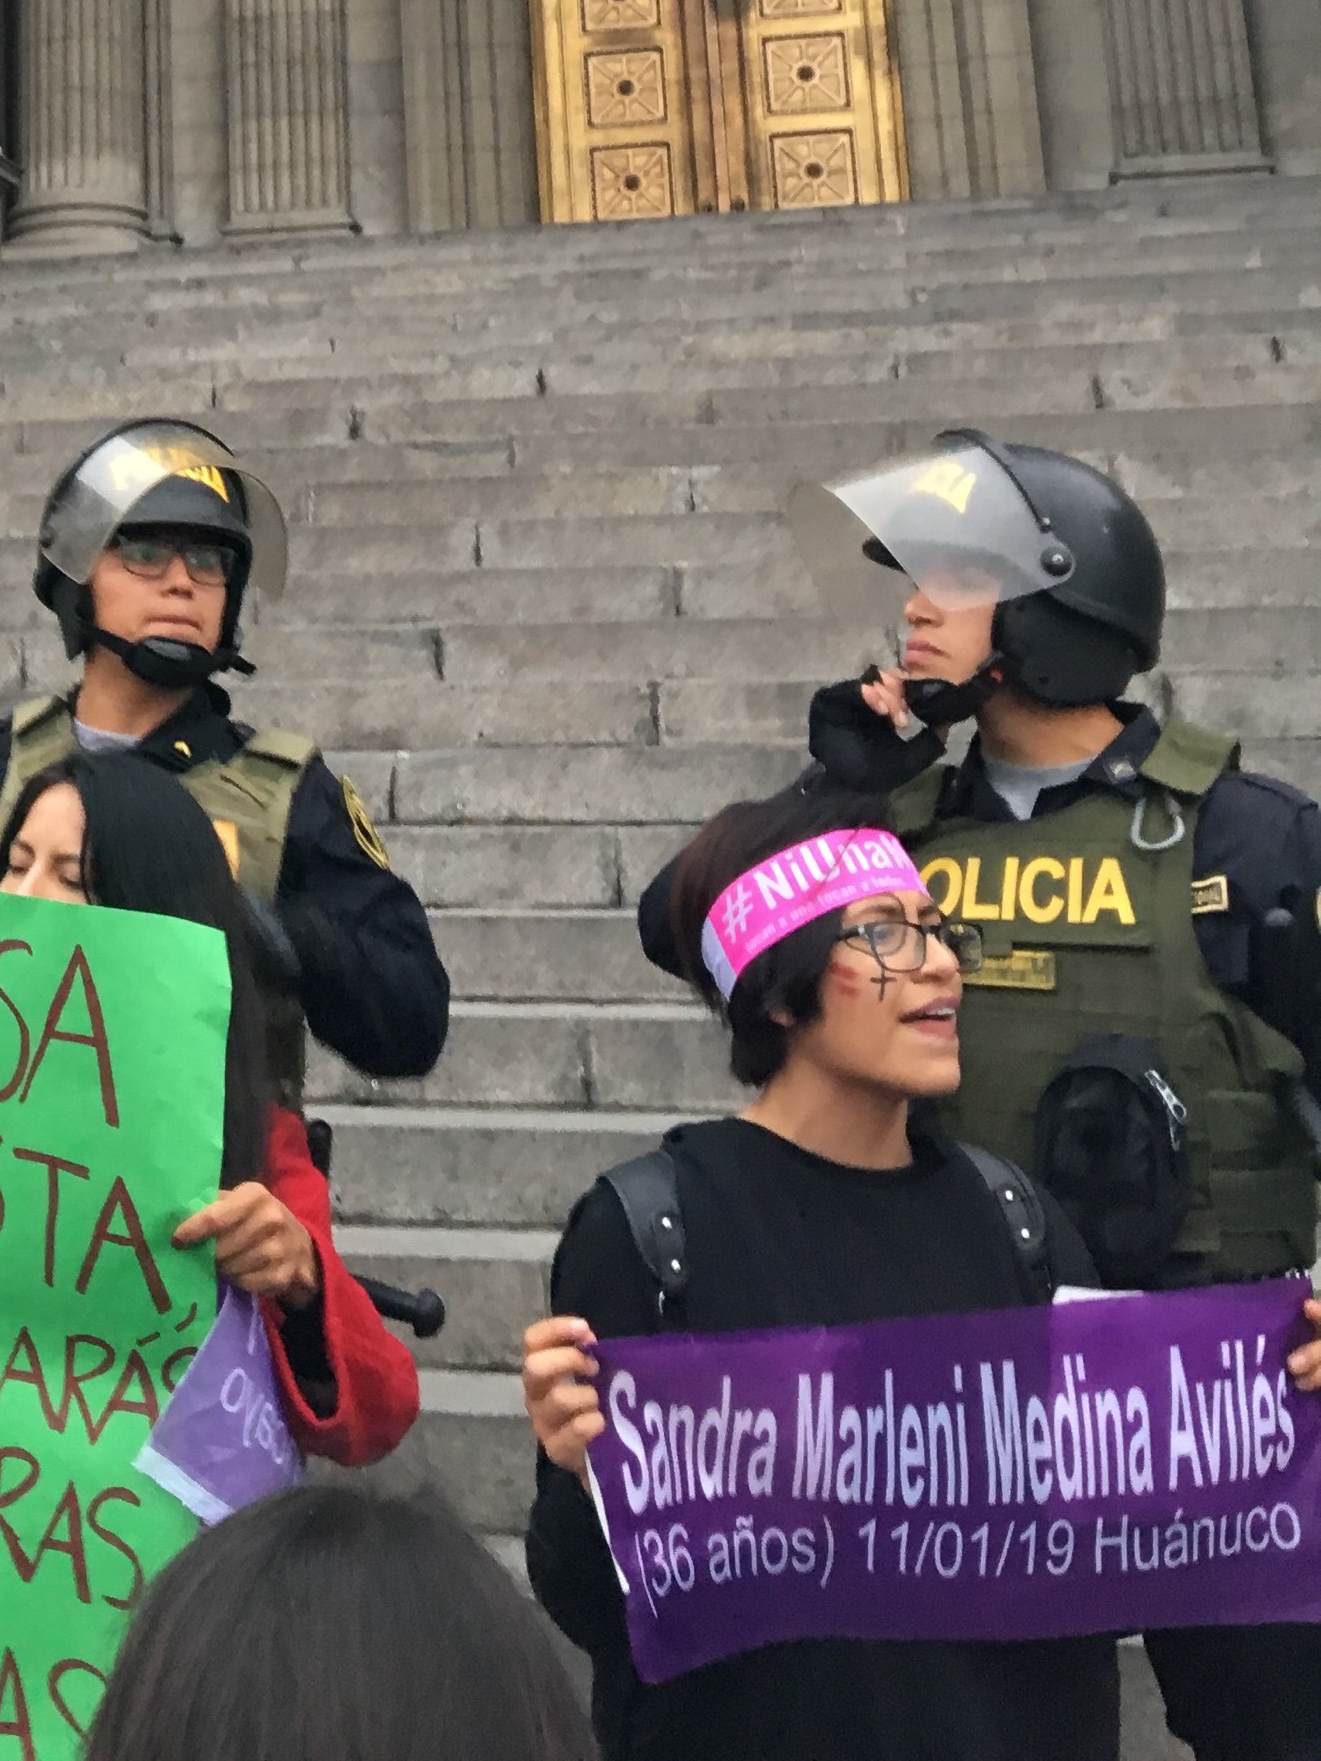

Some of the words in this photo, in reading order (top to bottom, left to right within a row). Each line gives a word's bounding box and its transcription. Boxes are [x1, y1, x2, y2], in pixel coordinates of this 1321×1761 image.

[919, 857, 1136, 925] OLICIA
[609, 1369, 778, 1517] Sandra
[791, 1366, 970, 1508] Marleni
[980, 1354, 1154, 1508] Medina
[1168, 1334, 1296, 1491] Avilés
[634, 1517, 693, 1619] (36
[708, 1513, 834, 1588] años)
[857, 1517, 1075, 1579] 11/01/19
[1095, 1500, 1302, 1574] Huánuco
